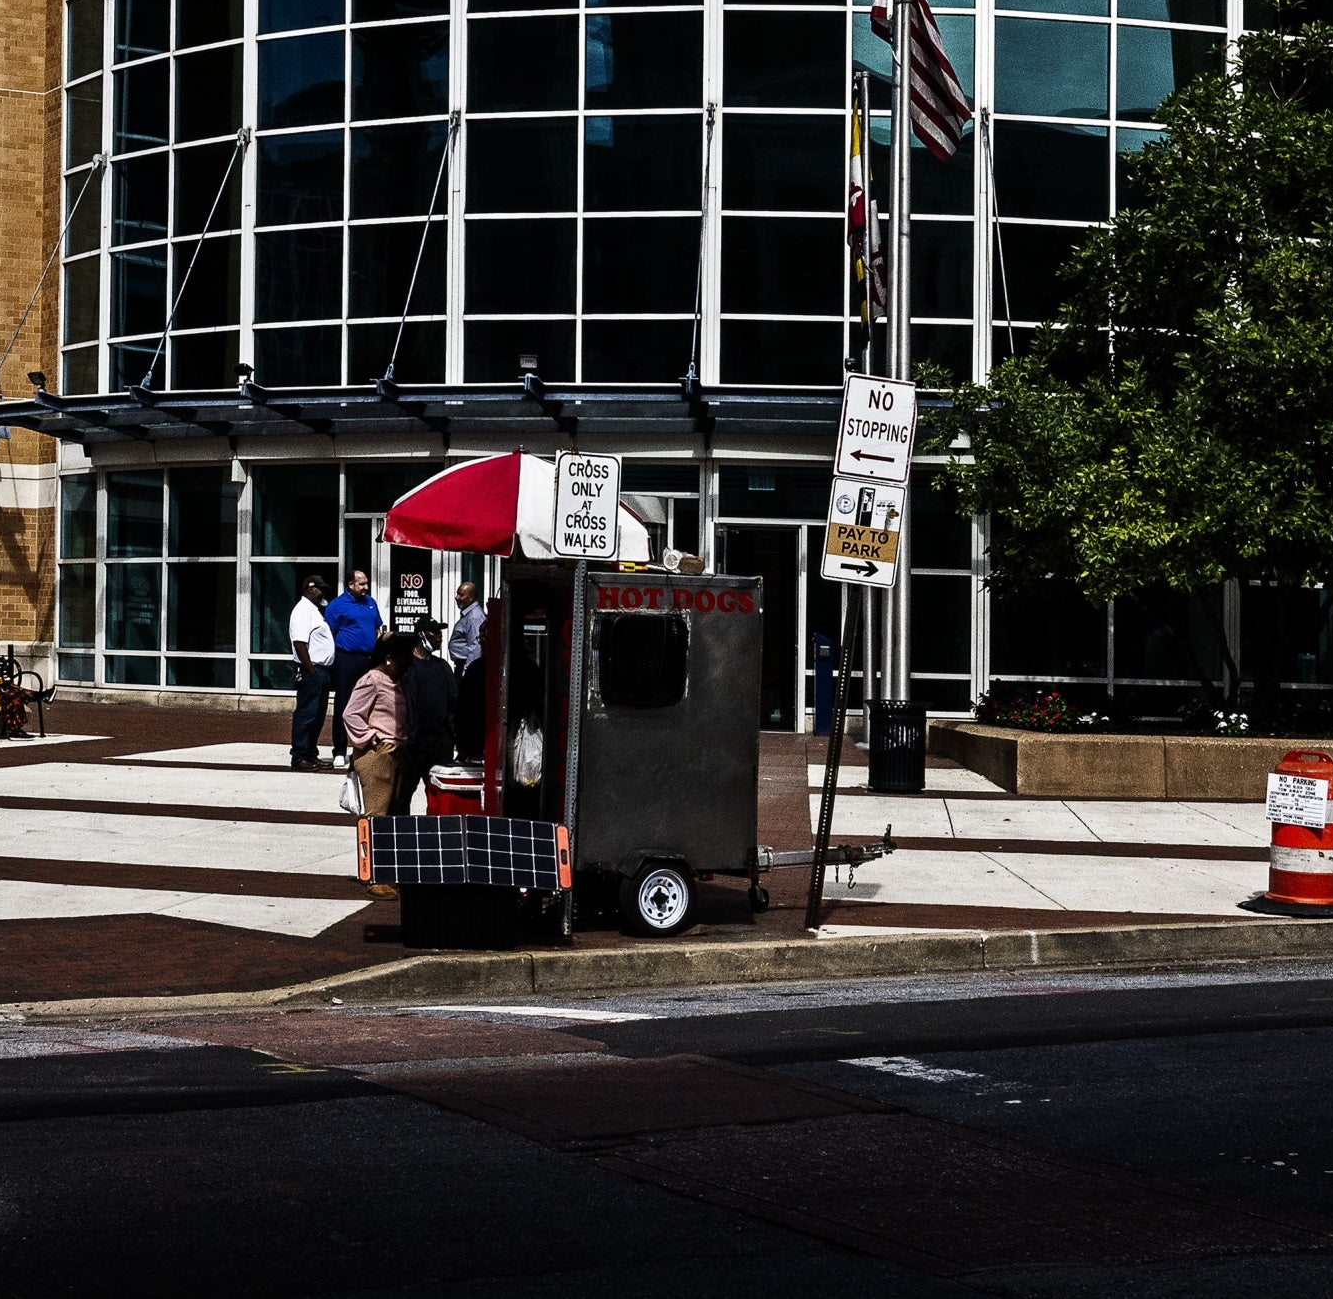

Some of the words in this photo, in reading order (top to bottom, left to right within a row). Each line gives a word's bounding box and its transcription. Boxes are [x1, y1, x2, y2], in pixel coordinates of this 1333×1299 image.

[868, 389, 894, 411] NO
[847, 418, 909, 443] STOPPING
[568, 462, 609, 479] CROSS
[571, 482, 604, 497] ONLY
[581, 500, 593, 510] AT
[565, 514, 606, 530] CROSS
[564, 532, 606, 549] WALKS
[837, 526, 866, 541] PAY
[869, 530, 889, 544] TO
[841, 541, 881, 558] PARK
[400, 574, 424, 589] NO
[596, 586, 665, 611] HOT
[671, 588, 755, 614] DOGS
[403, 606, 428, 614] WEAPONS
[1293, 777, 1316, 786] PARKING
